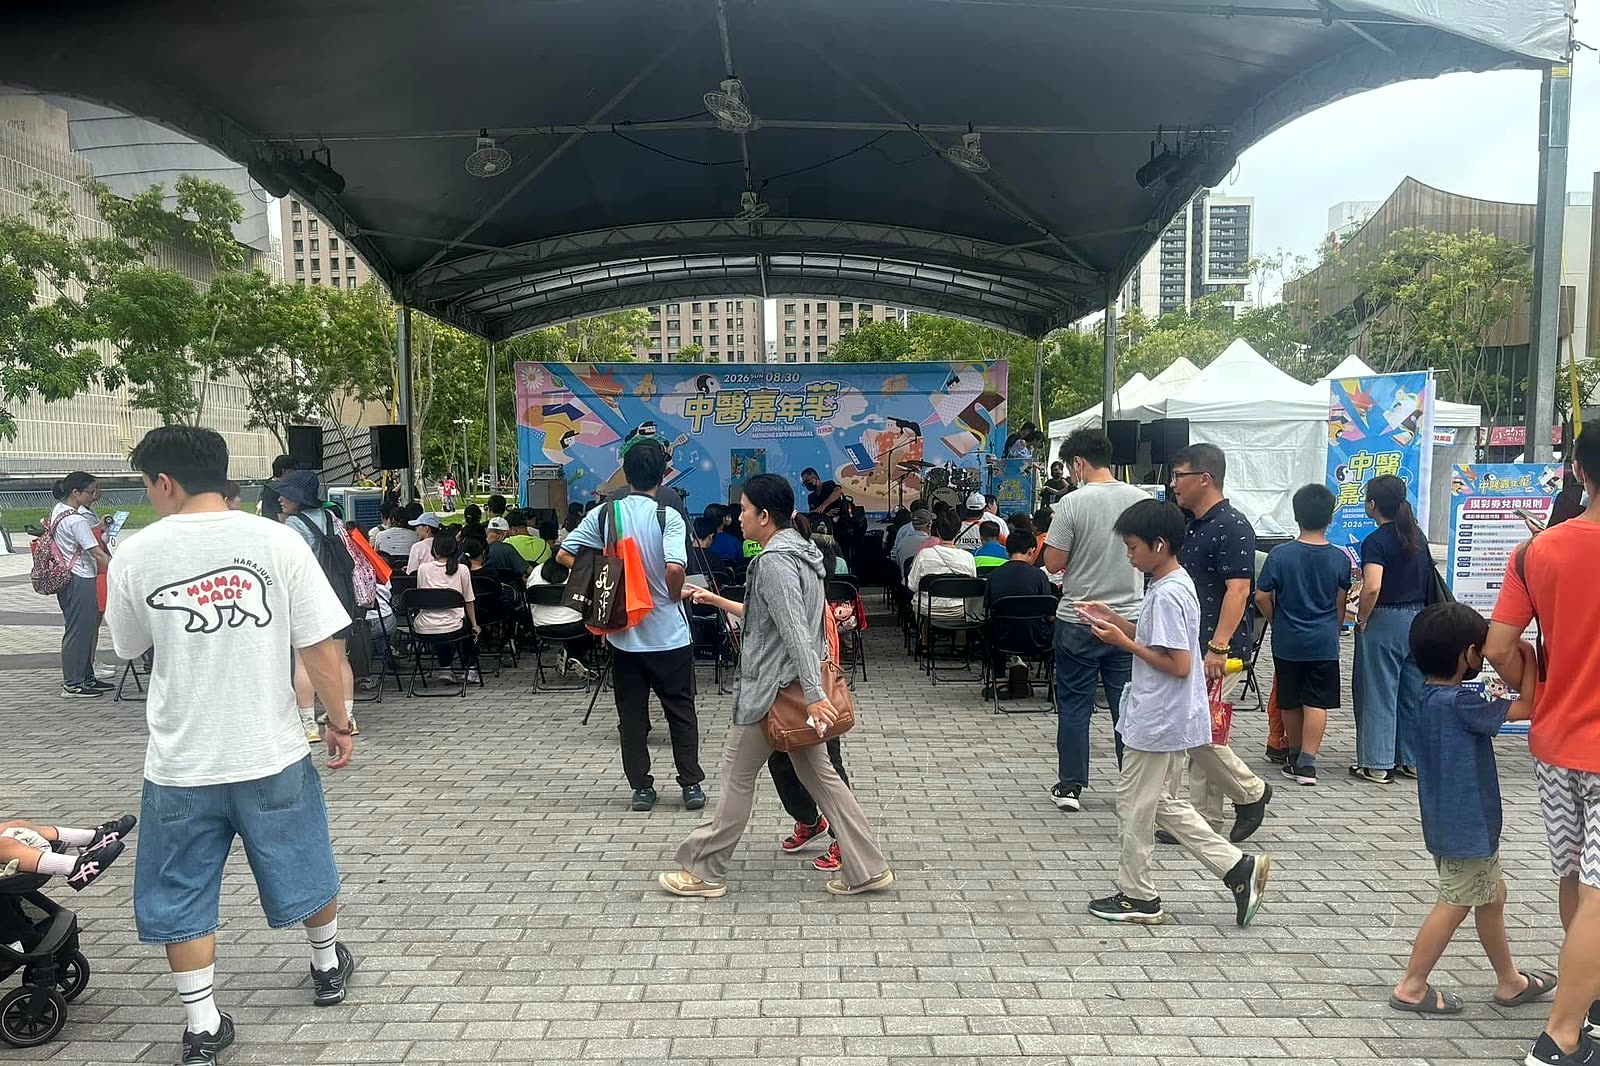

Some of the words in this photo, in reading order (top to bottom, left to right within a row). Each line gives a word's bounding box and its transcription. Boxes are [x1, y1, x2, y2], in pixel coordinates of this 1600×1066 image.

[724, 373, 750, 383] 2026
[766, 372, 800, 383] 08.30
[684, 381, 840, 434] 中醫嘉年華
[1349, 451, 1402, 481] 中醫
[233, 557, 273, 587] HARAJUKU
[187, 574, 252, 597] HUMAN
[197, 587, 243, 606] MADE
